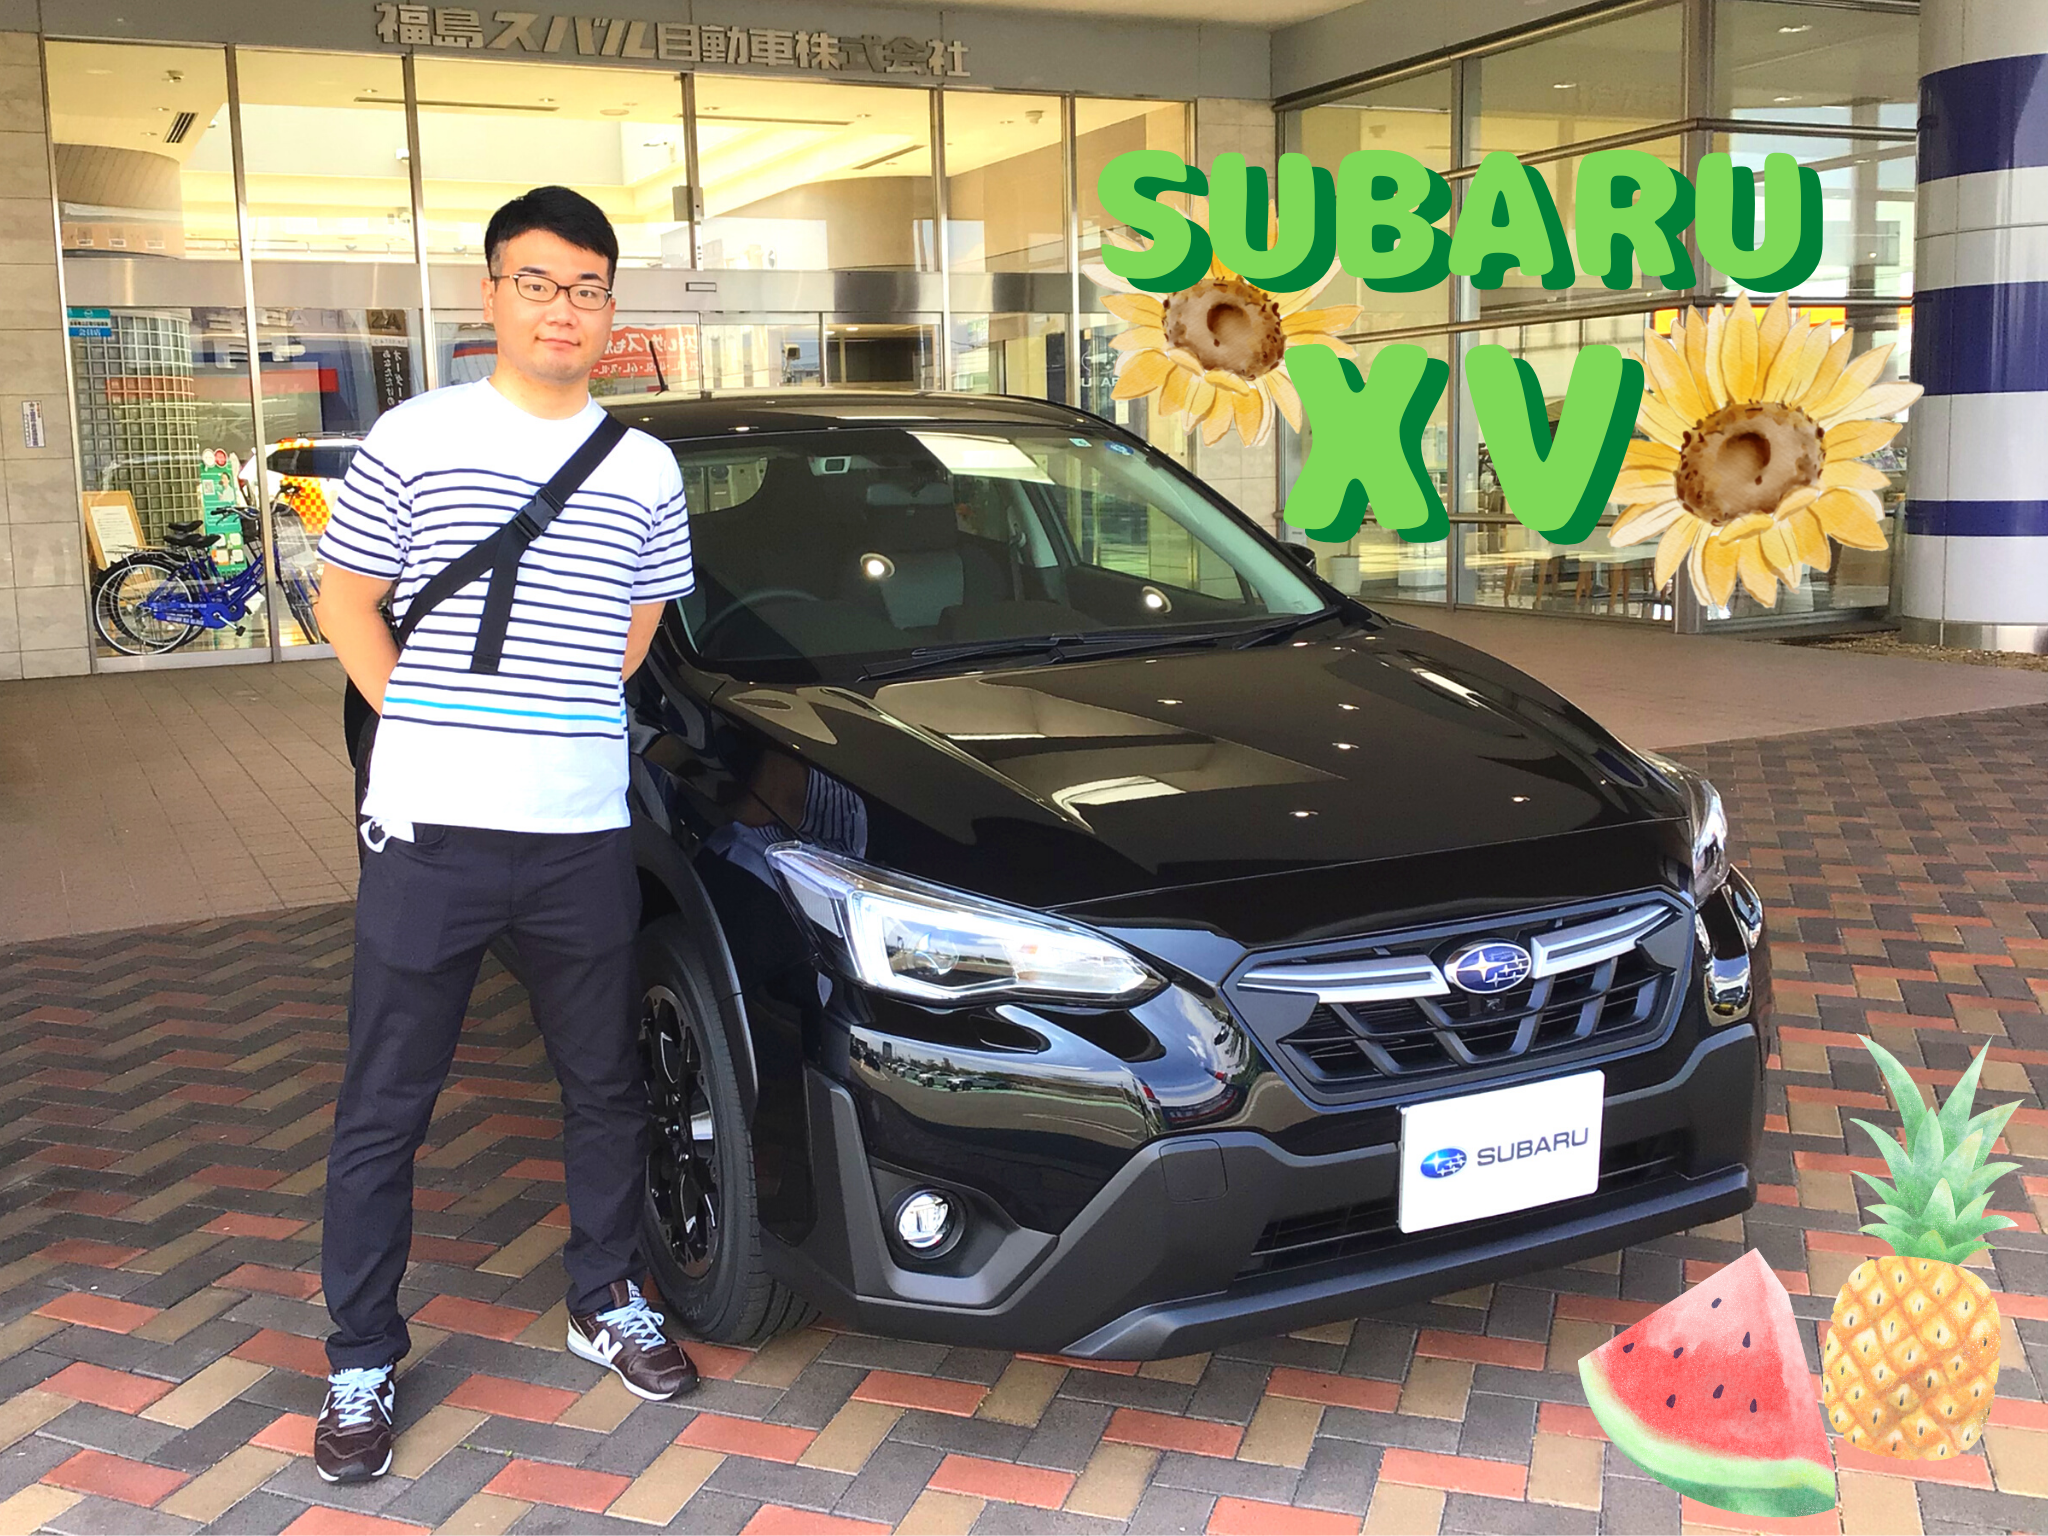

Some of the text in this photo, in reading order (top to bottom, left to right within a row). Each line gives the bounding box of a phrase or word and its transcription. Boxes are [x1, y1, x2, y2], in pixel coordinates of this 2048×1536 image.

[375, 2, 971, 78] 福島スバル自動車株式会社
[1476, 1127, 1589, 1167] SUBARU
[592, 1328, 624, 1364] N
